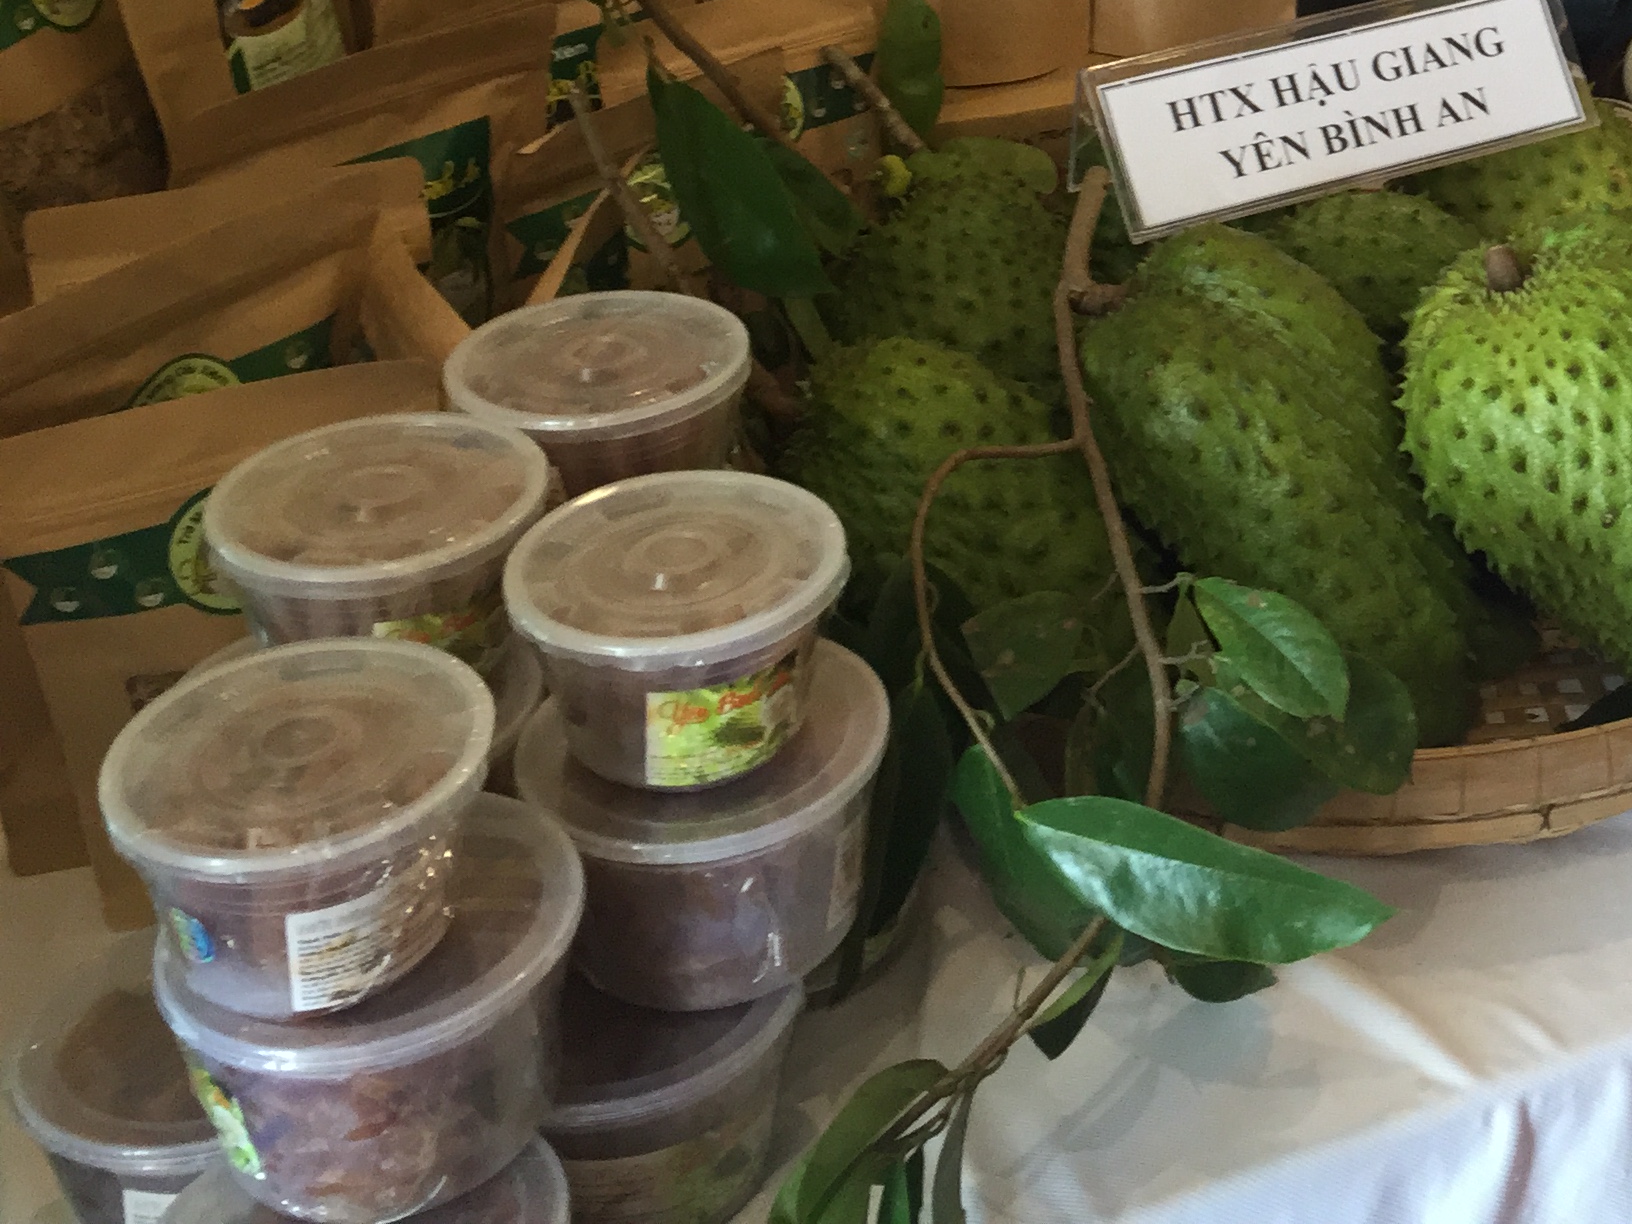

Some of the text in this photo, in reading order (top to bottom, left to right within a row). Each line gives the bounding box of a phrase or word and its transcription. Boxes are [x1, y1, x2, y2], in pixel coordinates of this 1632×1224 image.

[1166, 26, 1506, 133] HTX HẬU GIANG
[1218, 86, 1493, 180] YÊN BÌNH AN
